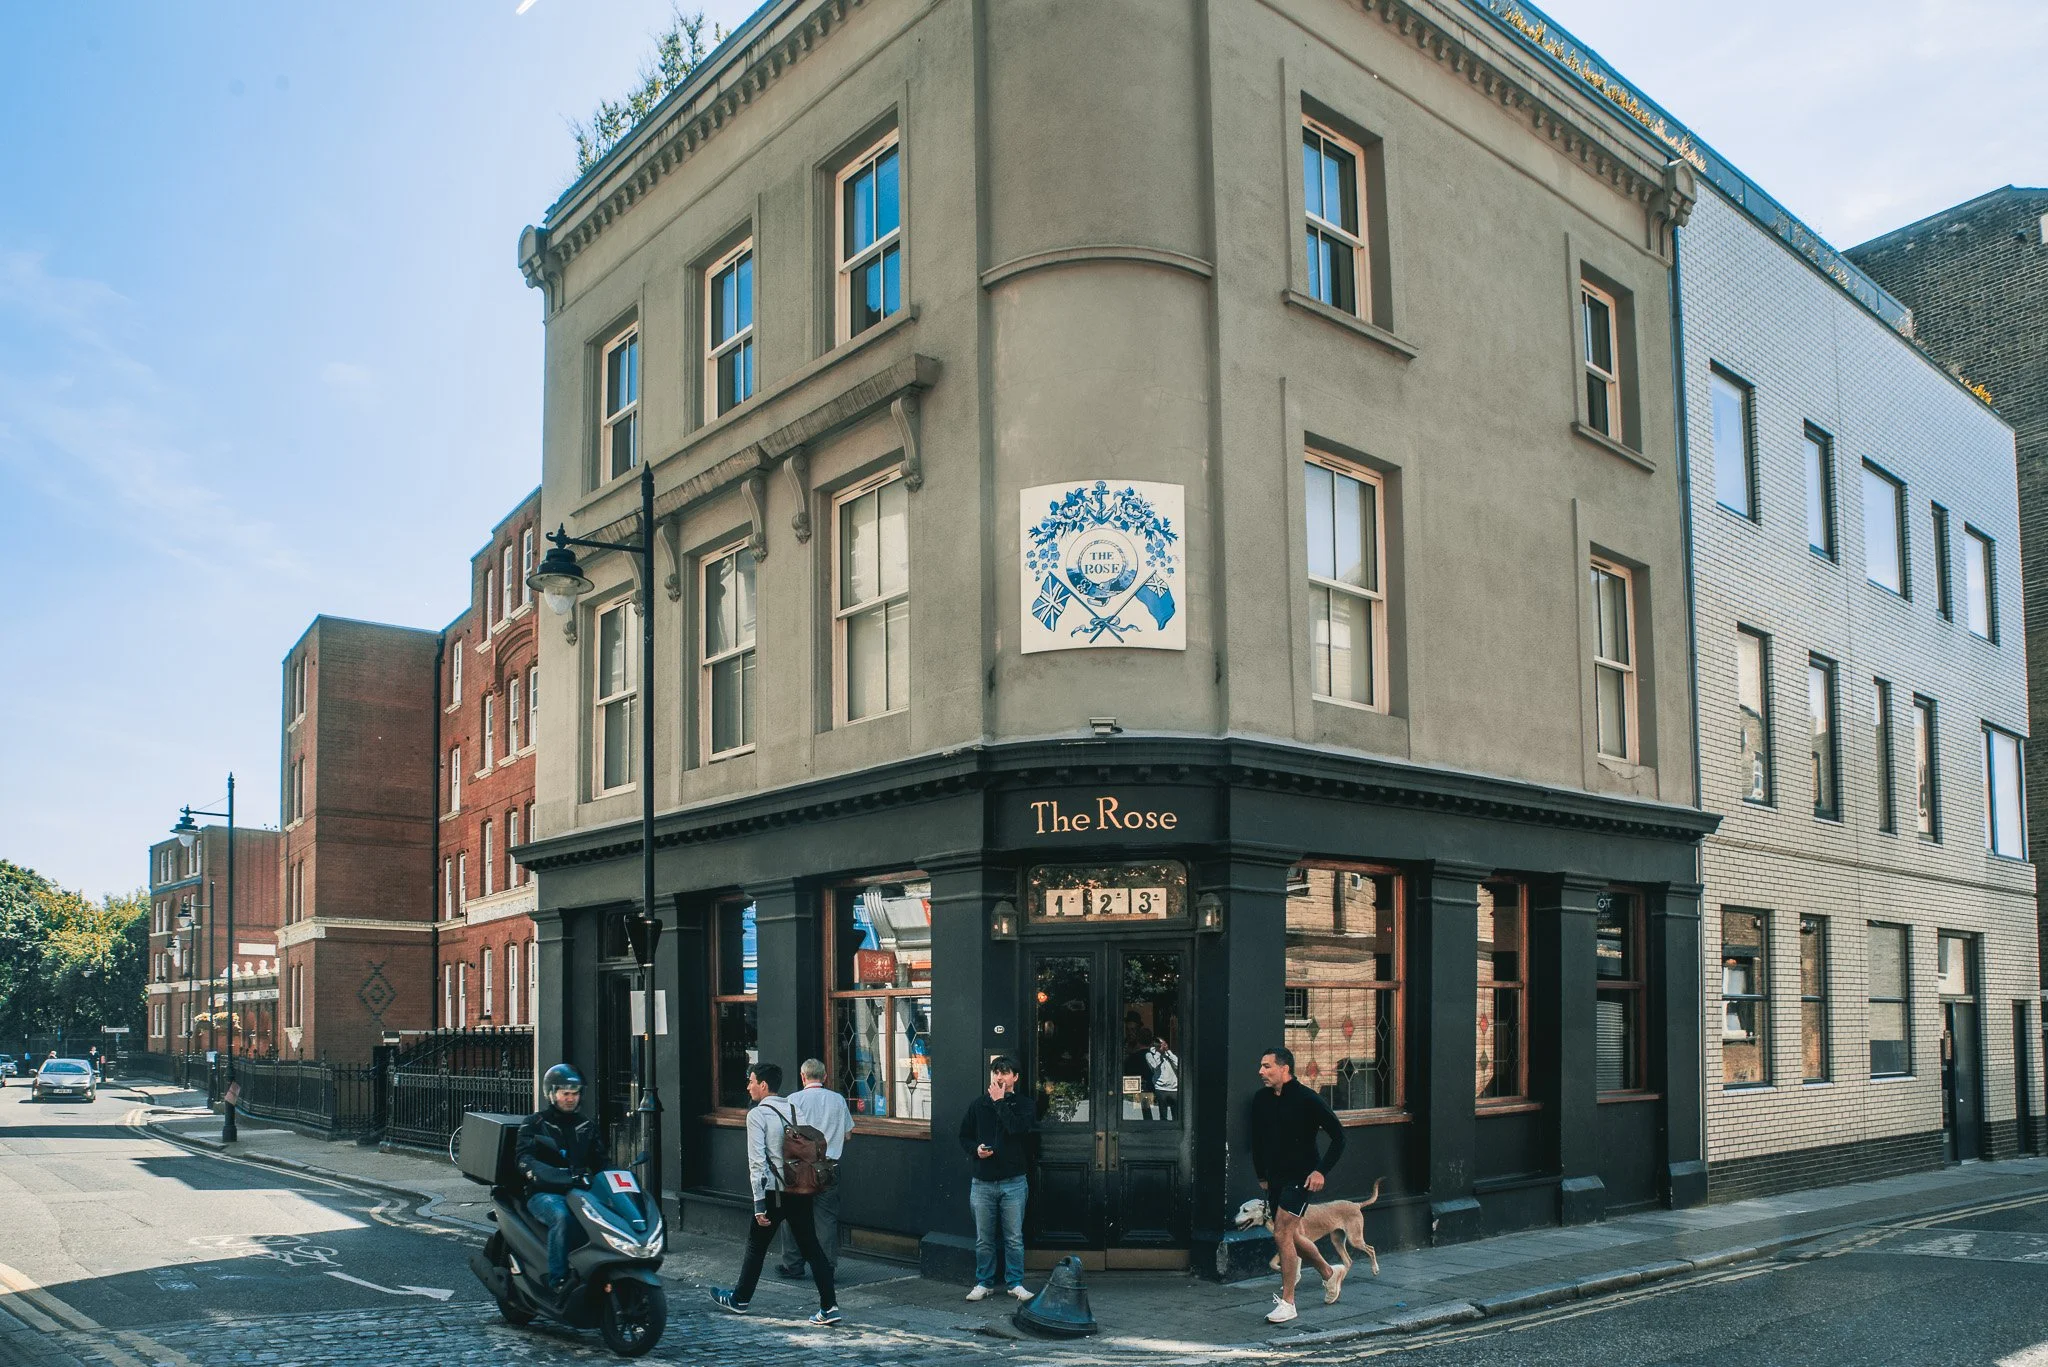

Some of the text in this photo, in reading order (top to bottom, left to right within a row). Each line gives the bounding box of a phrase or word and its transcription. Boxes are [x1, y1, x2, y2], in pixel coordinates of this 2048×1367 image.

[1089, 552, 1114, 560] THE
[1084, 563, 1120, 574] ROSE
[1030, 796, 1178, 834] The Rose
[613, 1173, 632, 1187] L
